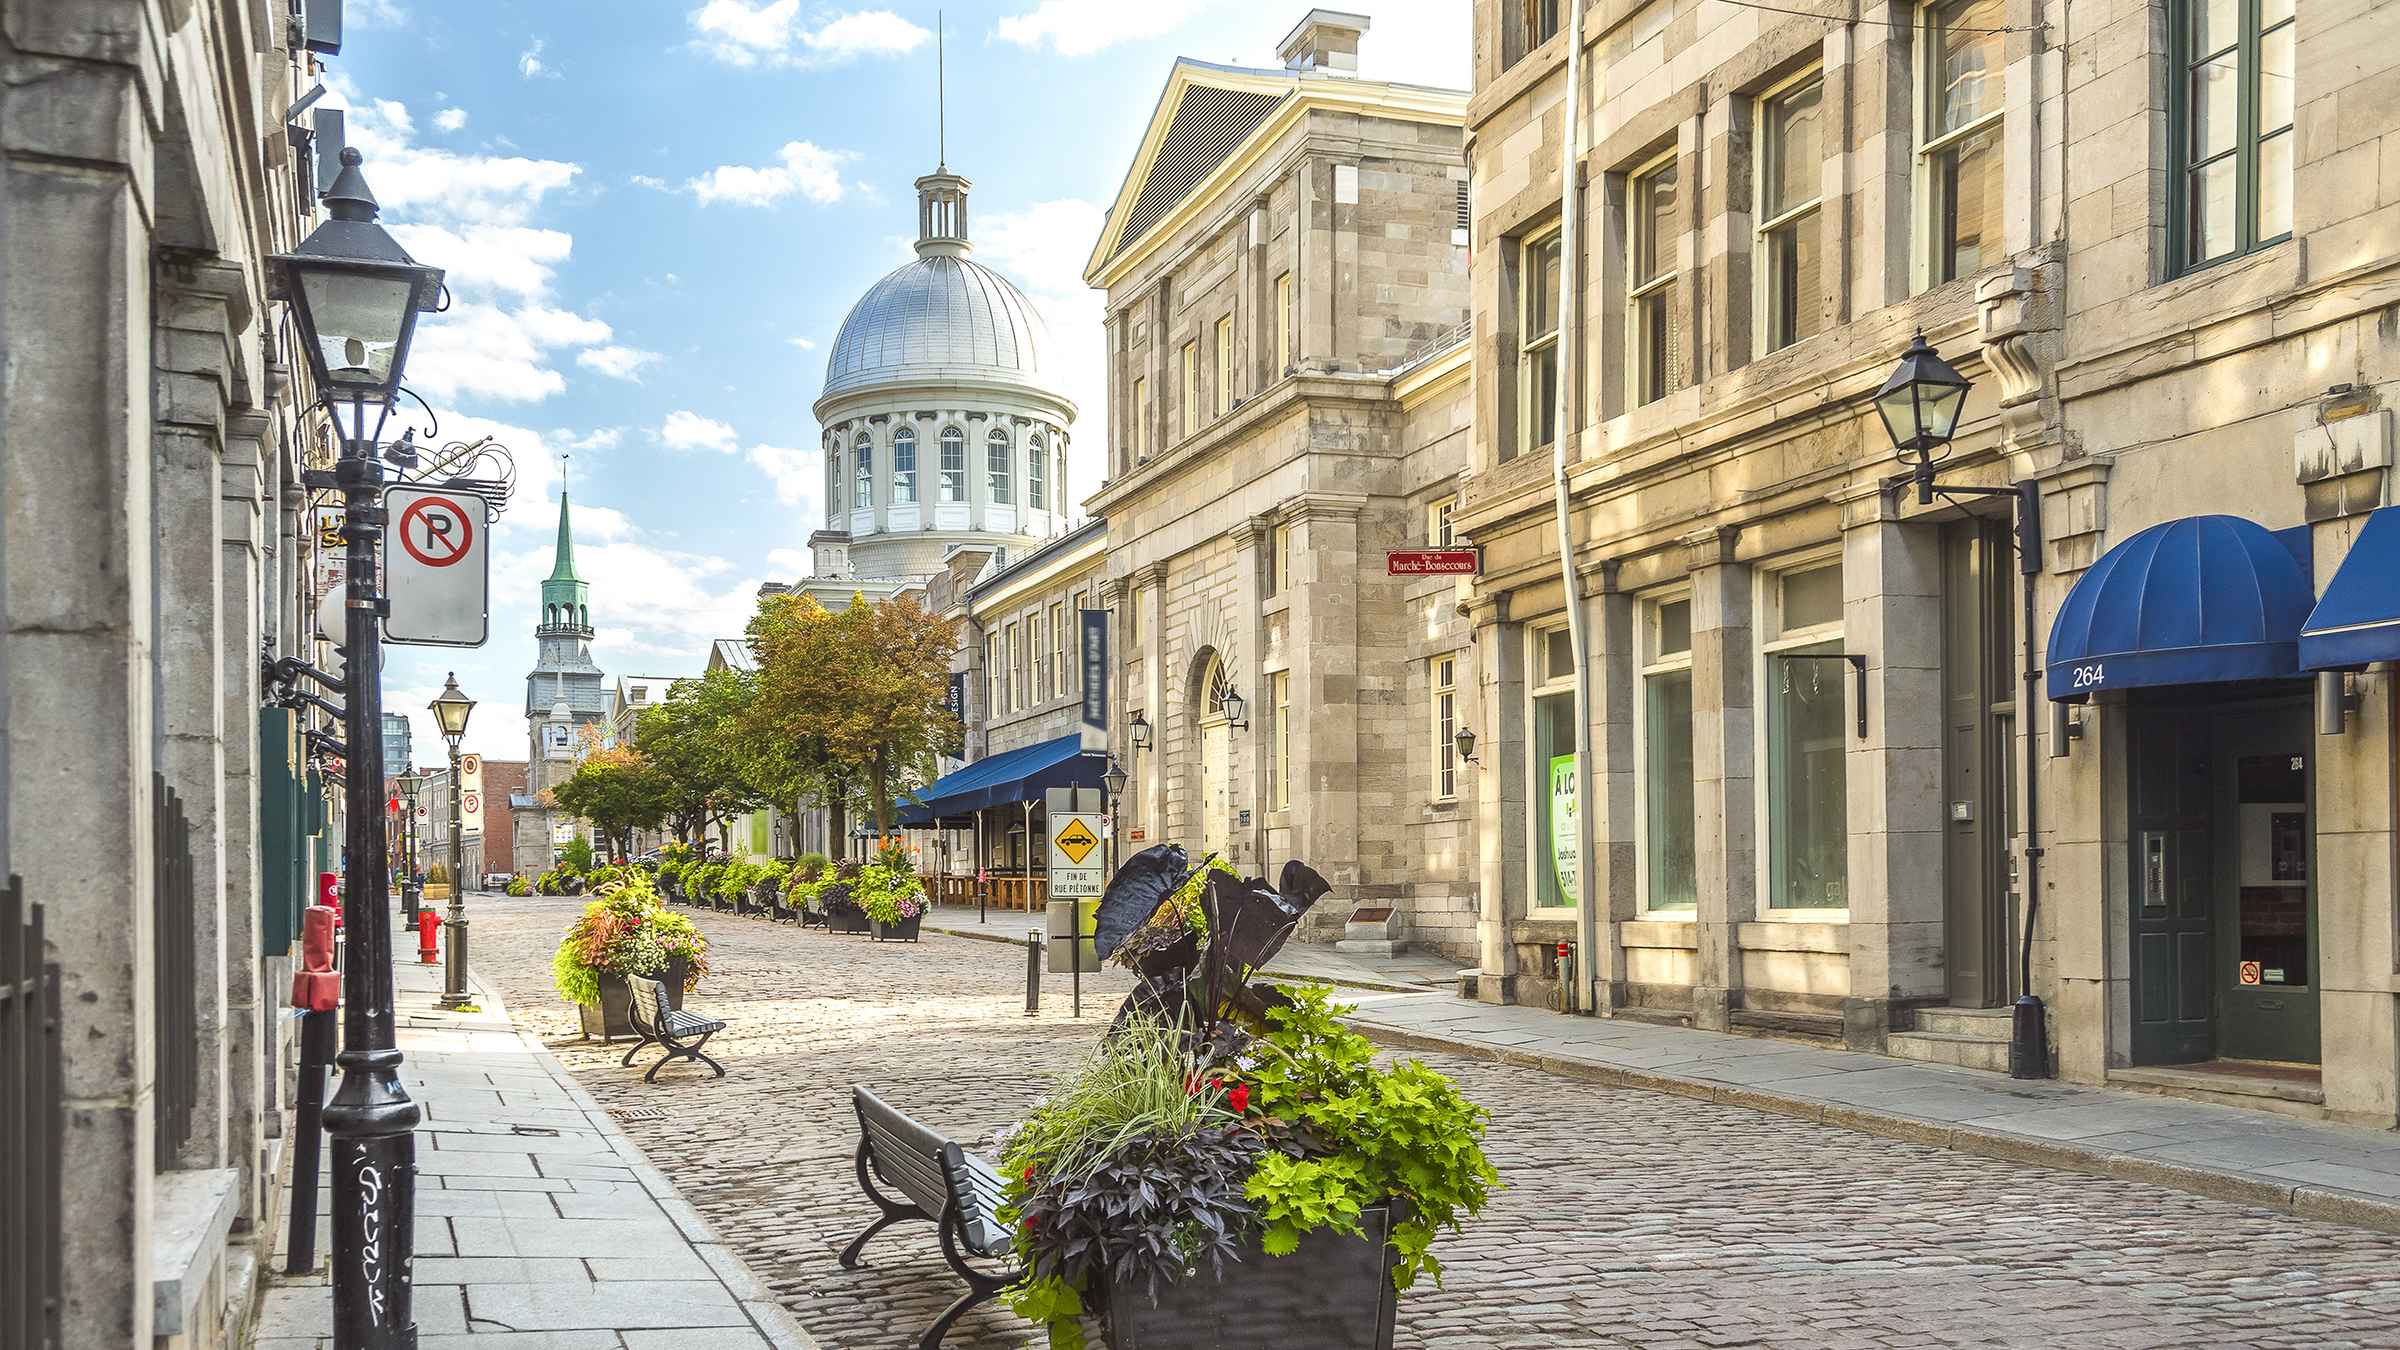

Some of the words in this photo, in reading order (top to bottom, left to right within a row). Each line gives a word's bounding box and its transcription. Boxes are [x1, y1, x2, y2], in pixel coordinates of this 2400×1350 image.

[2073, 663, 2105, 688] 264
[1066, 872, 1077, 881] FIN
[1079, 872, 1087, 881] DE
[1055, 885, 1067, 893] RUE
